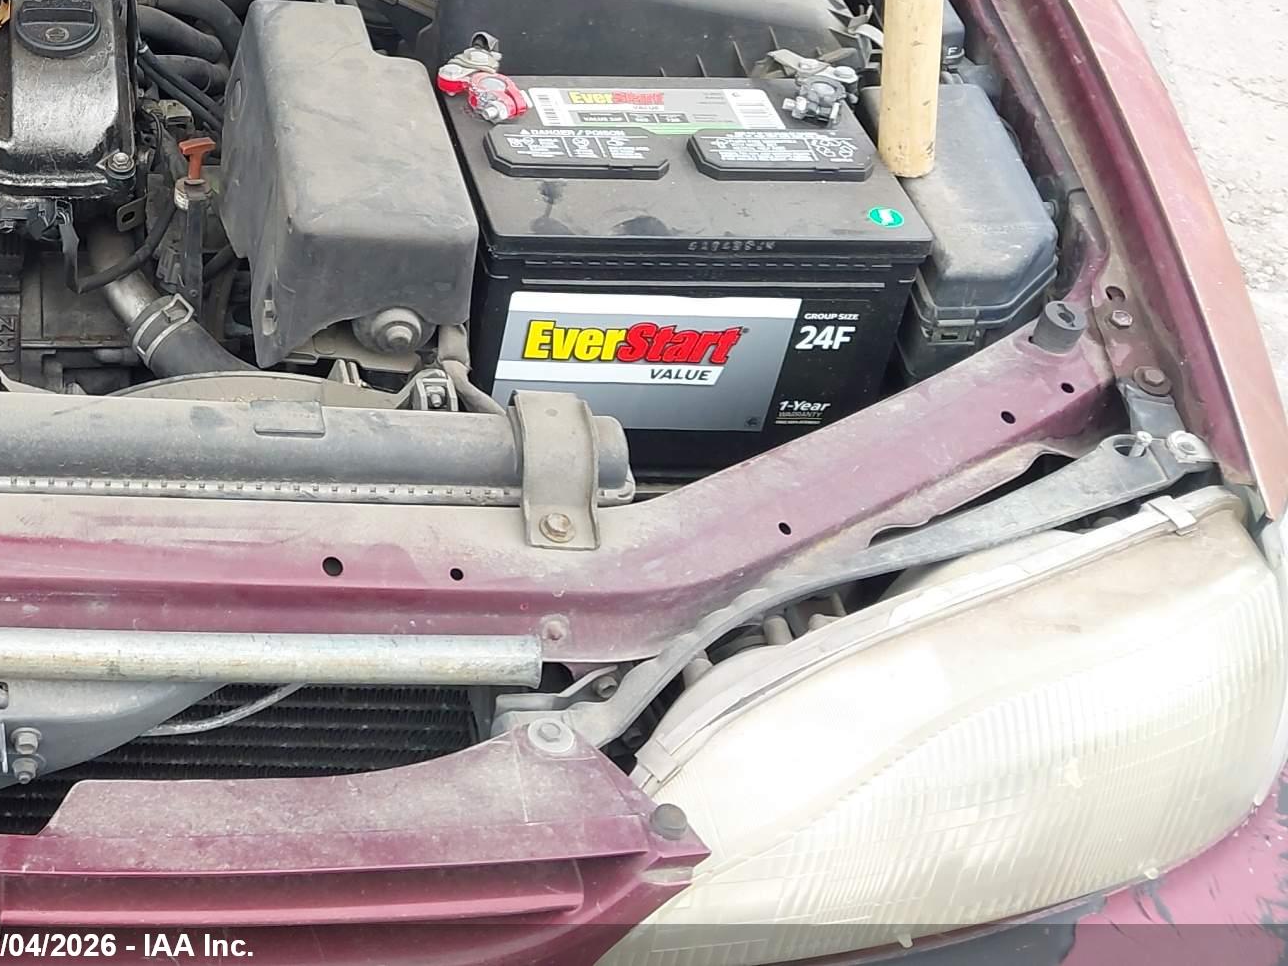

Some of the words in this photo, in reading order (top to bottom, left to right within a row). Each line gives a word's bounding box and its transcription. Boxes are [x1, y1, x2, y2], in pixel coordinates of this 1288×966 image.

[568, 91, 664, 105] EverStart
[584, 129, 626, 137] POISON
[804, 313, 838, 321] GROUP
[838, 313, 860, 321] SIZE
[522, 319, 744, 365] EverStart
[795, 325, 856, 350] 24F
[650, 368, 712, 381] VALUE
[779, 400, 831, 411] 1-Year
